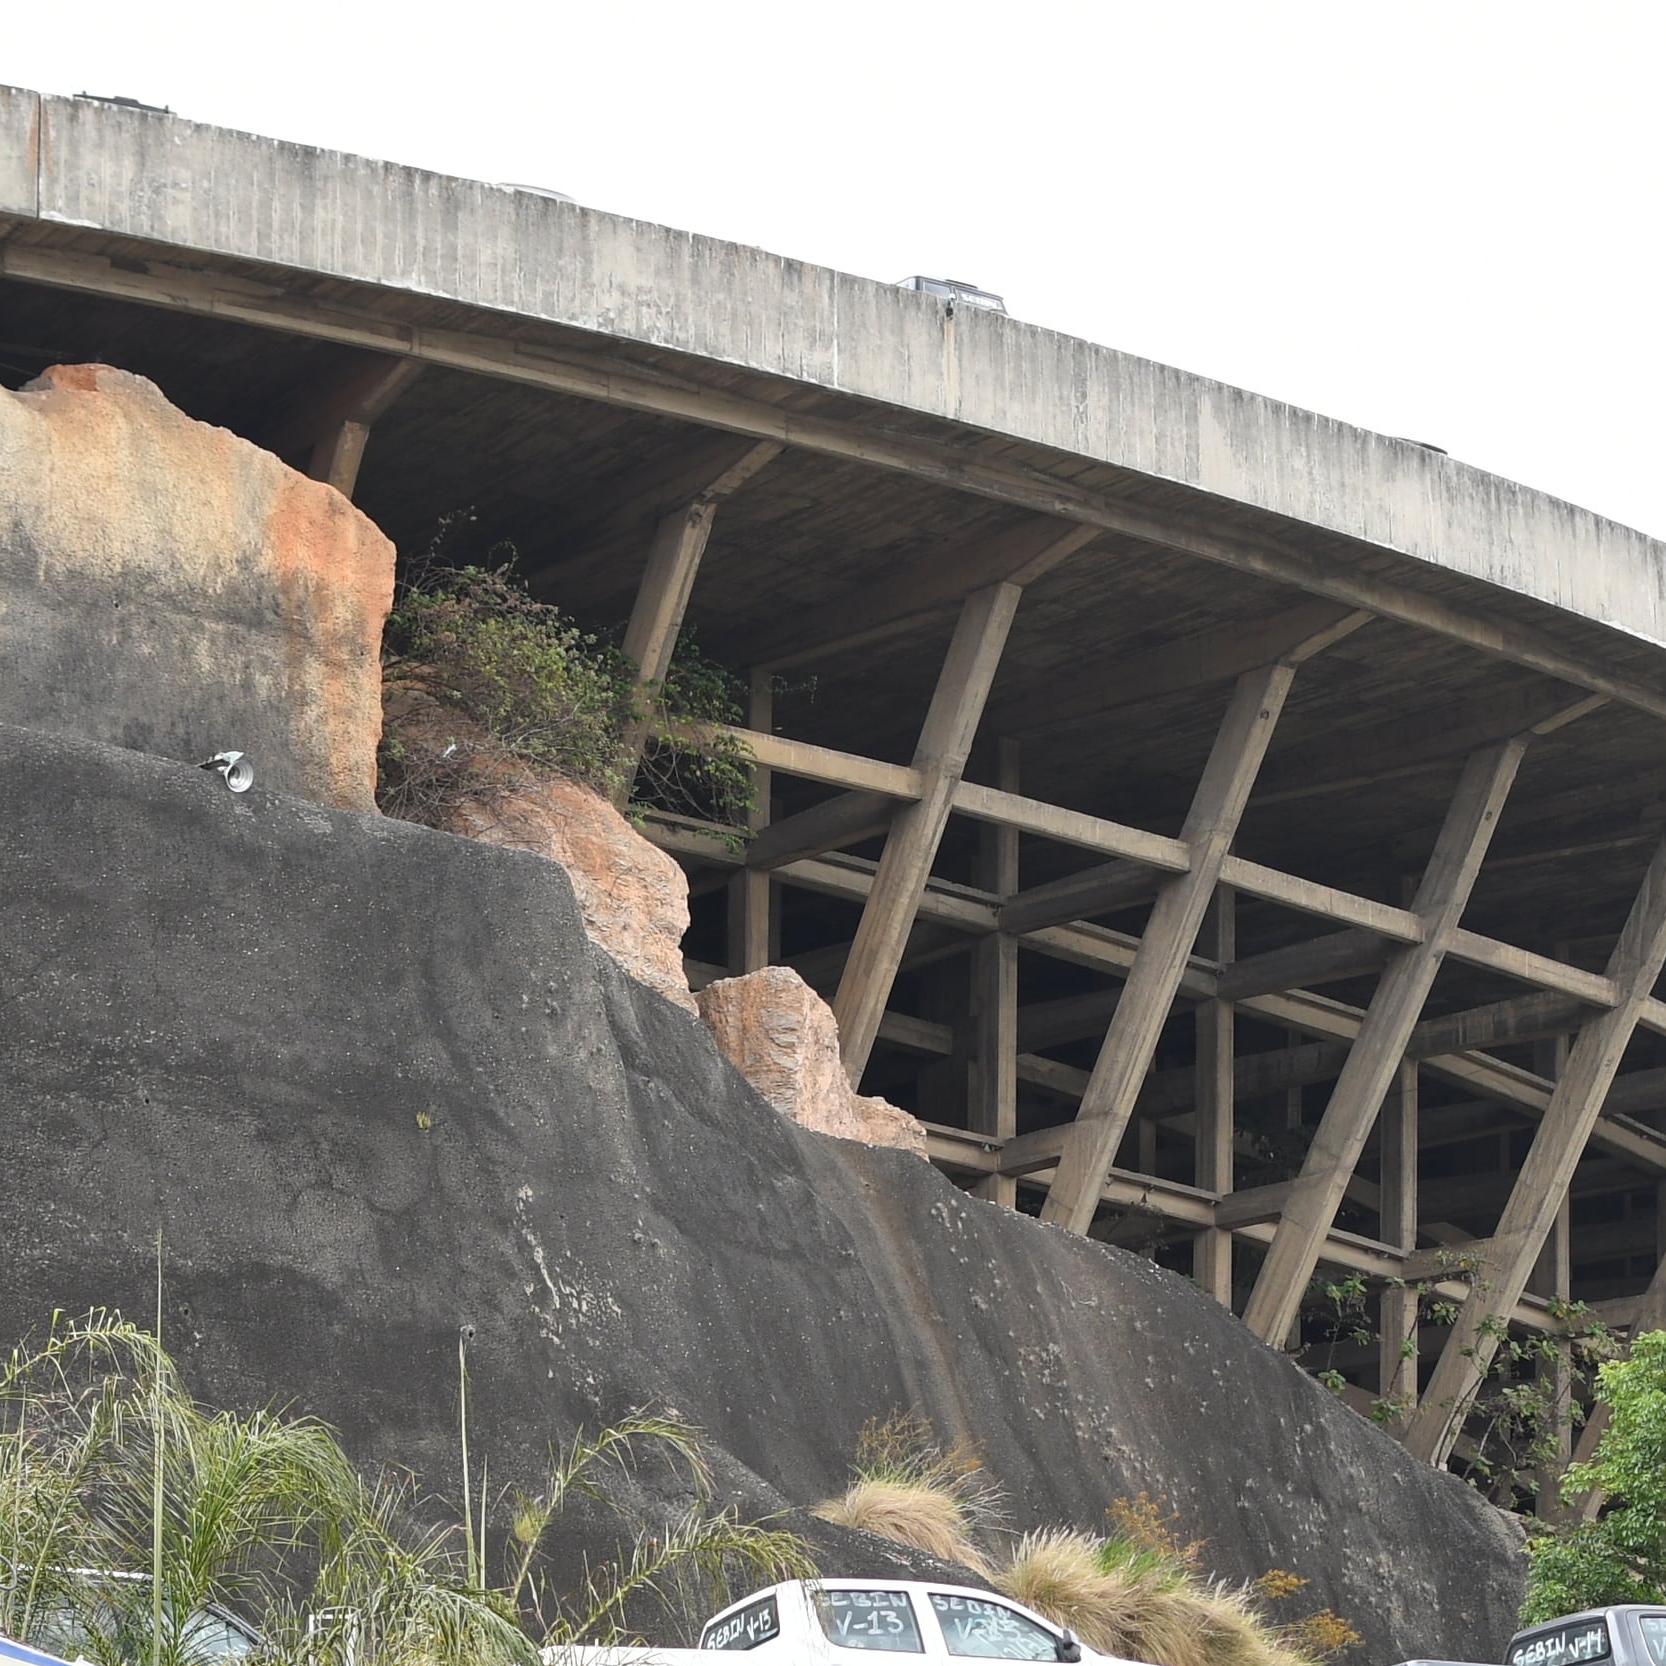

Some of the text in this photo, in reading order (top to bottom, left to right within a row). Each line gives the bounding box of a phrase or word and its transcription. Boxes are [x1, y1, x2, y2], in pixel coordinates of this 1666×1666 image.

[707, 1607, 772, 1650] SEBIN V-13
[836, 1610, 904, 1636] V-13
[1513, 1628, 1603, 1666] SEBIN V-14
